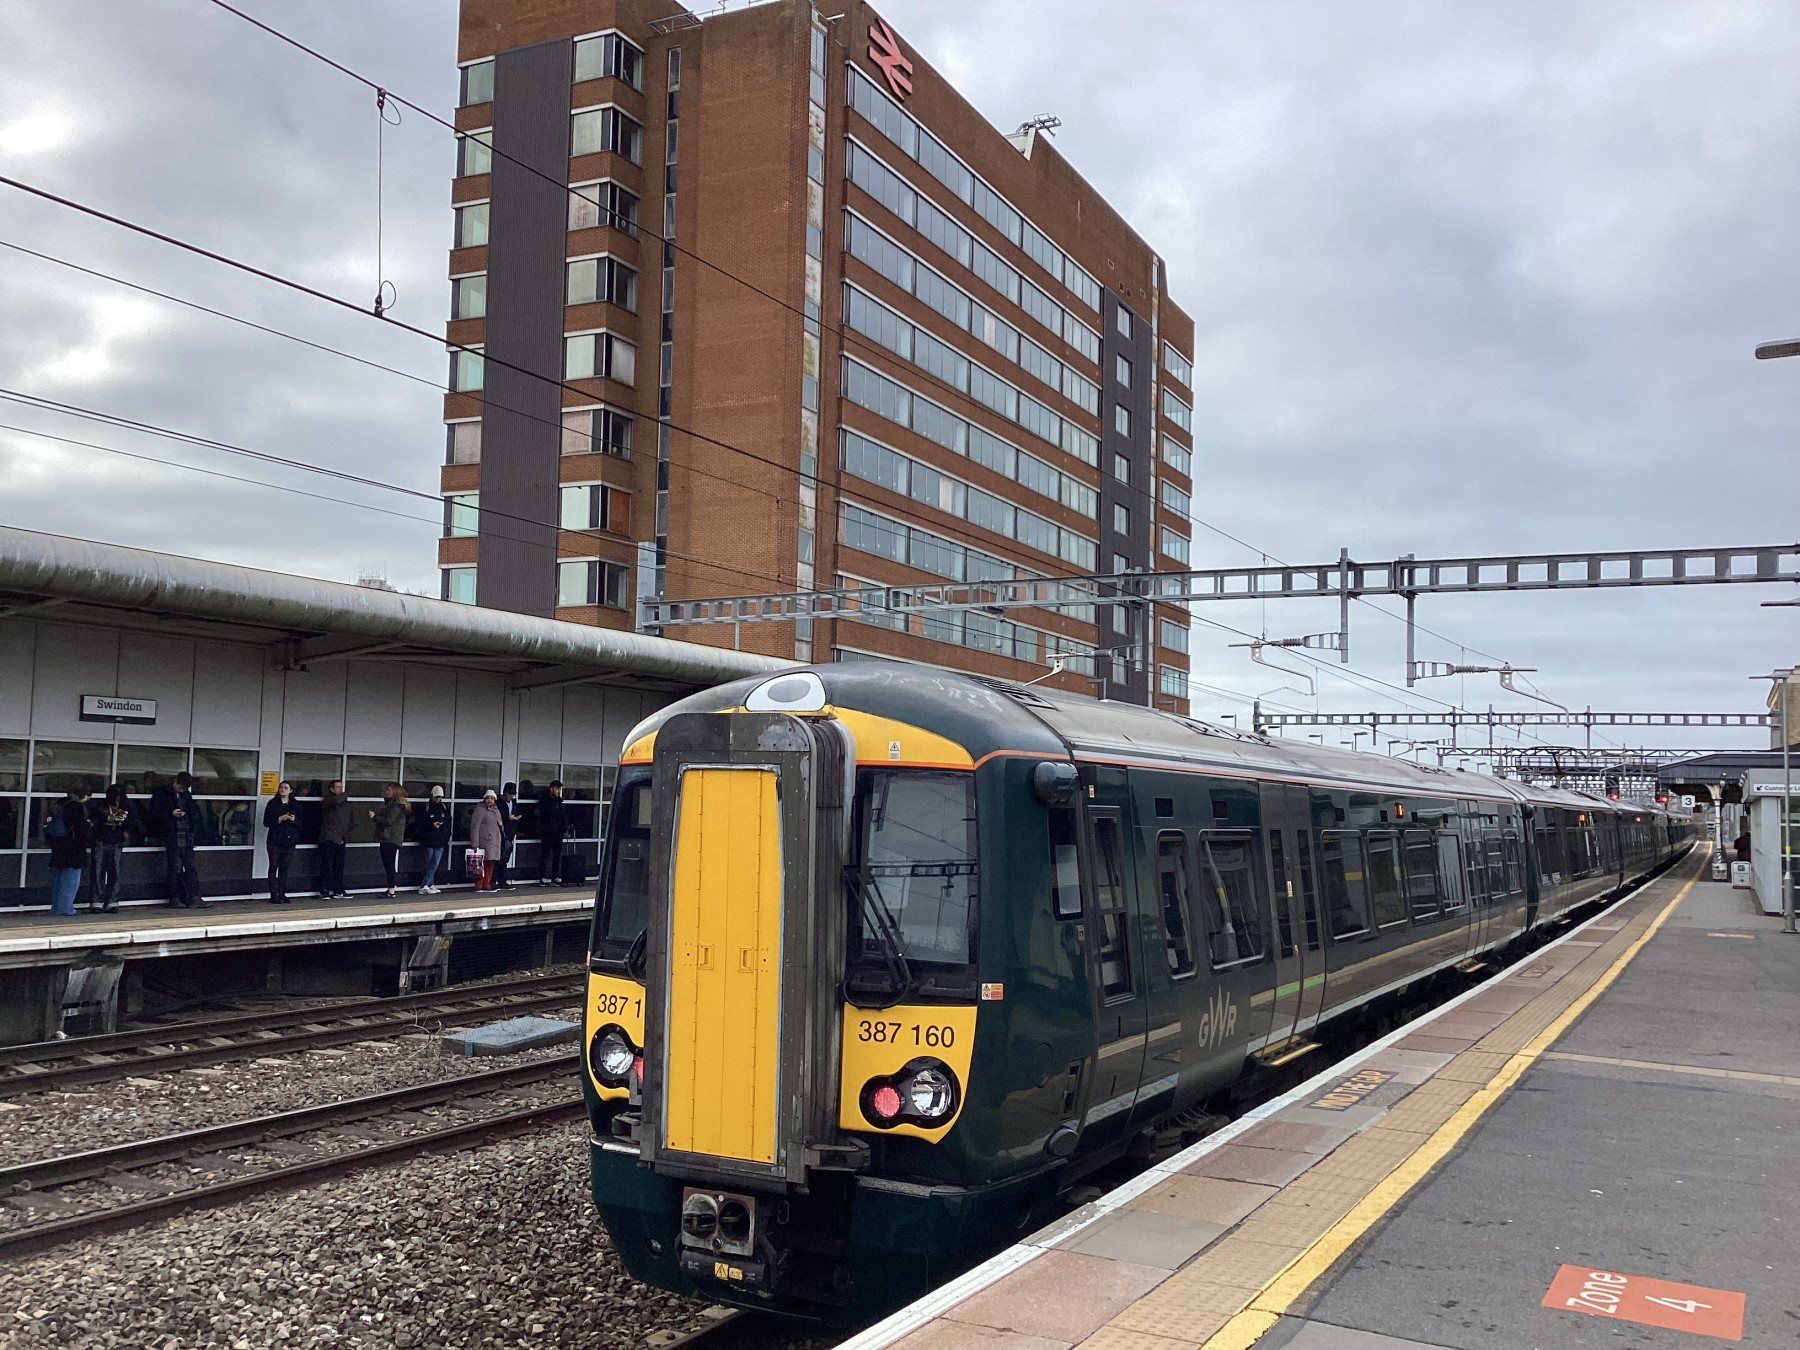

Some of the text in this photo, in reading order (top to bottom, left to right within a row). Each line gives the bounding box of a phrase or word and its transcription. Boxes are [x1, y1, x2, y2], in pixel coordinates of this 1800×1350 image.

[97, 699, 142, 711] Swindon
[1685, 797, 1692, 806] 3
[597, 993, 629, 1015] 387
[1199, 985, 1237, 1052] GWR
[858, 1020, 955, 1048] 387 160
[1333, 1081, 1378, 1095] THE
[1566, 1272, 1628, 1314] Zone
[1644, 1295, 1713, 1313] 4
